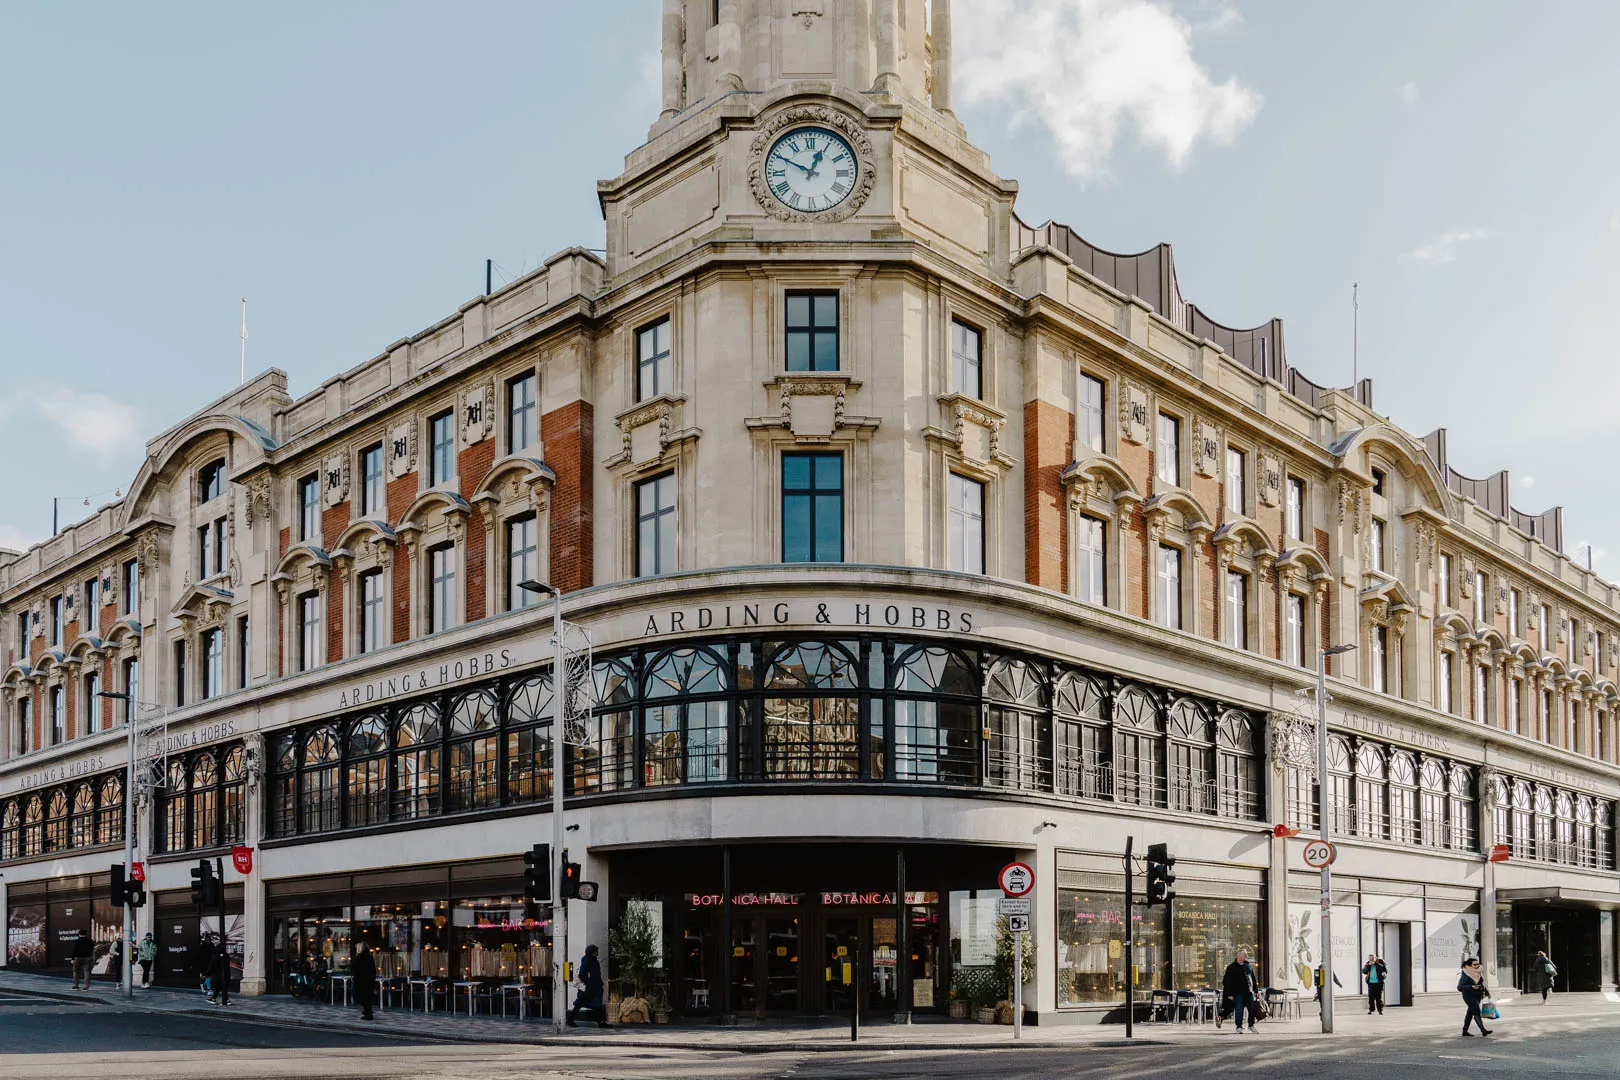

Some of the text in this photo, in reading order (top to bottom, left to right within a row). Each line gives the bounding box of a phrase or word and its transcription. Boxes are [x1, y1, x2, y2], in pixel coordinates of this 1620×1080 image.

[788, 142, 800, 154] XI
[804, 138, 816, 150] XII
[822, 142, 830, 152] I
[832, 154, 844, 164] II
[836, 170, 850, 178] III
[644, 603, 789, 635] ARDING
[815, 603, 831, 624] &
[855, 603, 972, 633] HOBBS
[339, 674, 411, 708] ARDING
[419, 670, 428, 688] &
[439, 649, 509, 684] HOBBS
[191, 730, 198, 745] &
[200, 720, 234, 743] HOBBS
[1342, 711, 1449, 752] ARDING & HOBBS
[20, 756, 104, 789] ARDING & HOBBS
[1529, 761, 1561, 780] ARDING
[1308, 847, 1328, 860] 20
[692, 895, 798, 906] BOTANICA HALL
[823, 894, 930, 905] BOTANICA ALL
[1101, 910, 1121, 923] BAR
[1178, 911, 1203, 919] BOTANICA
[501, 918, 523, 931] BAR
